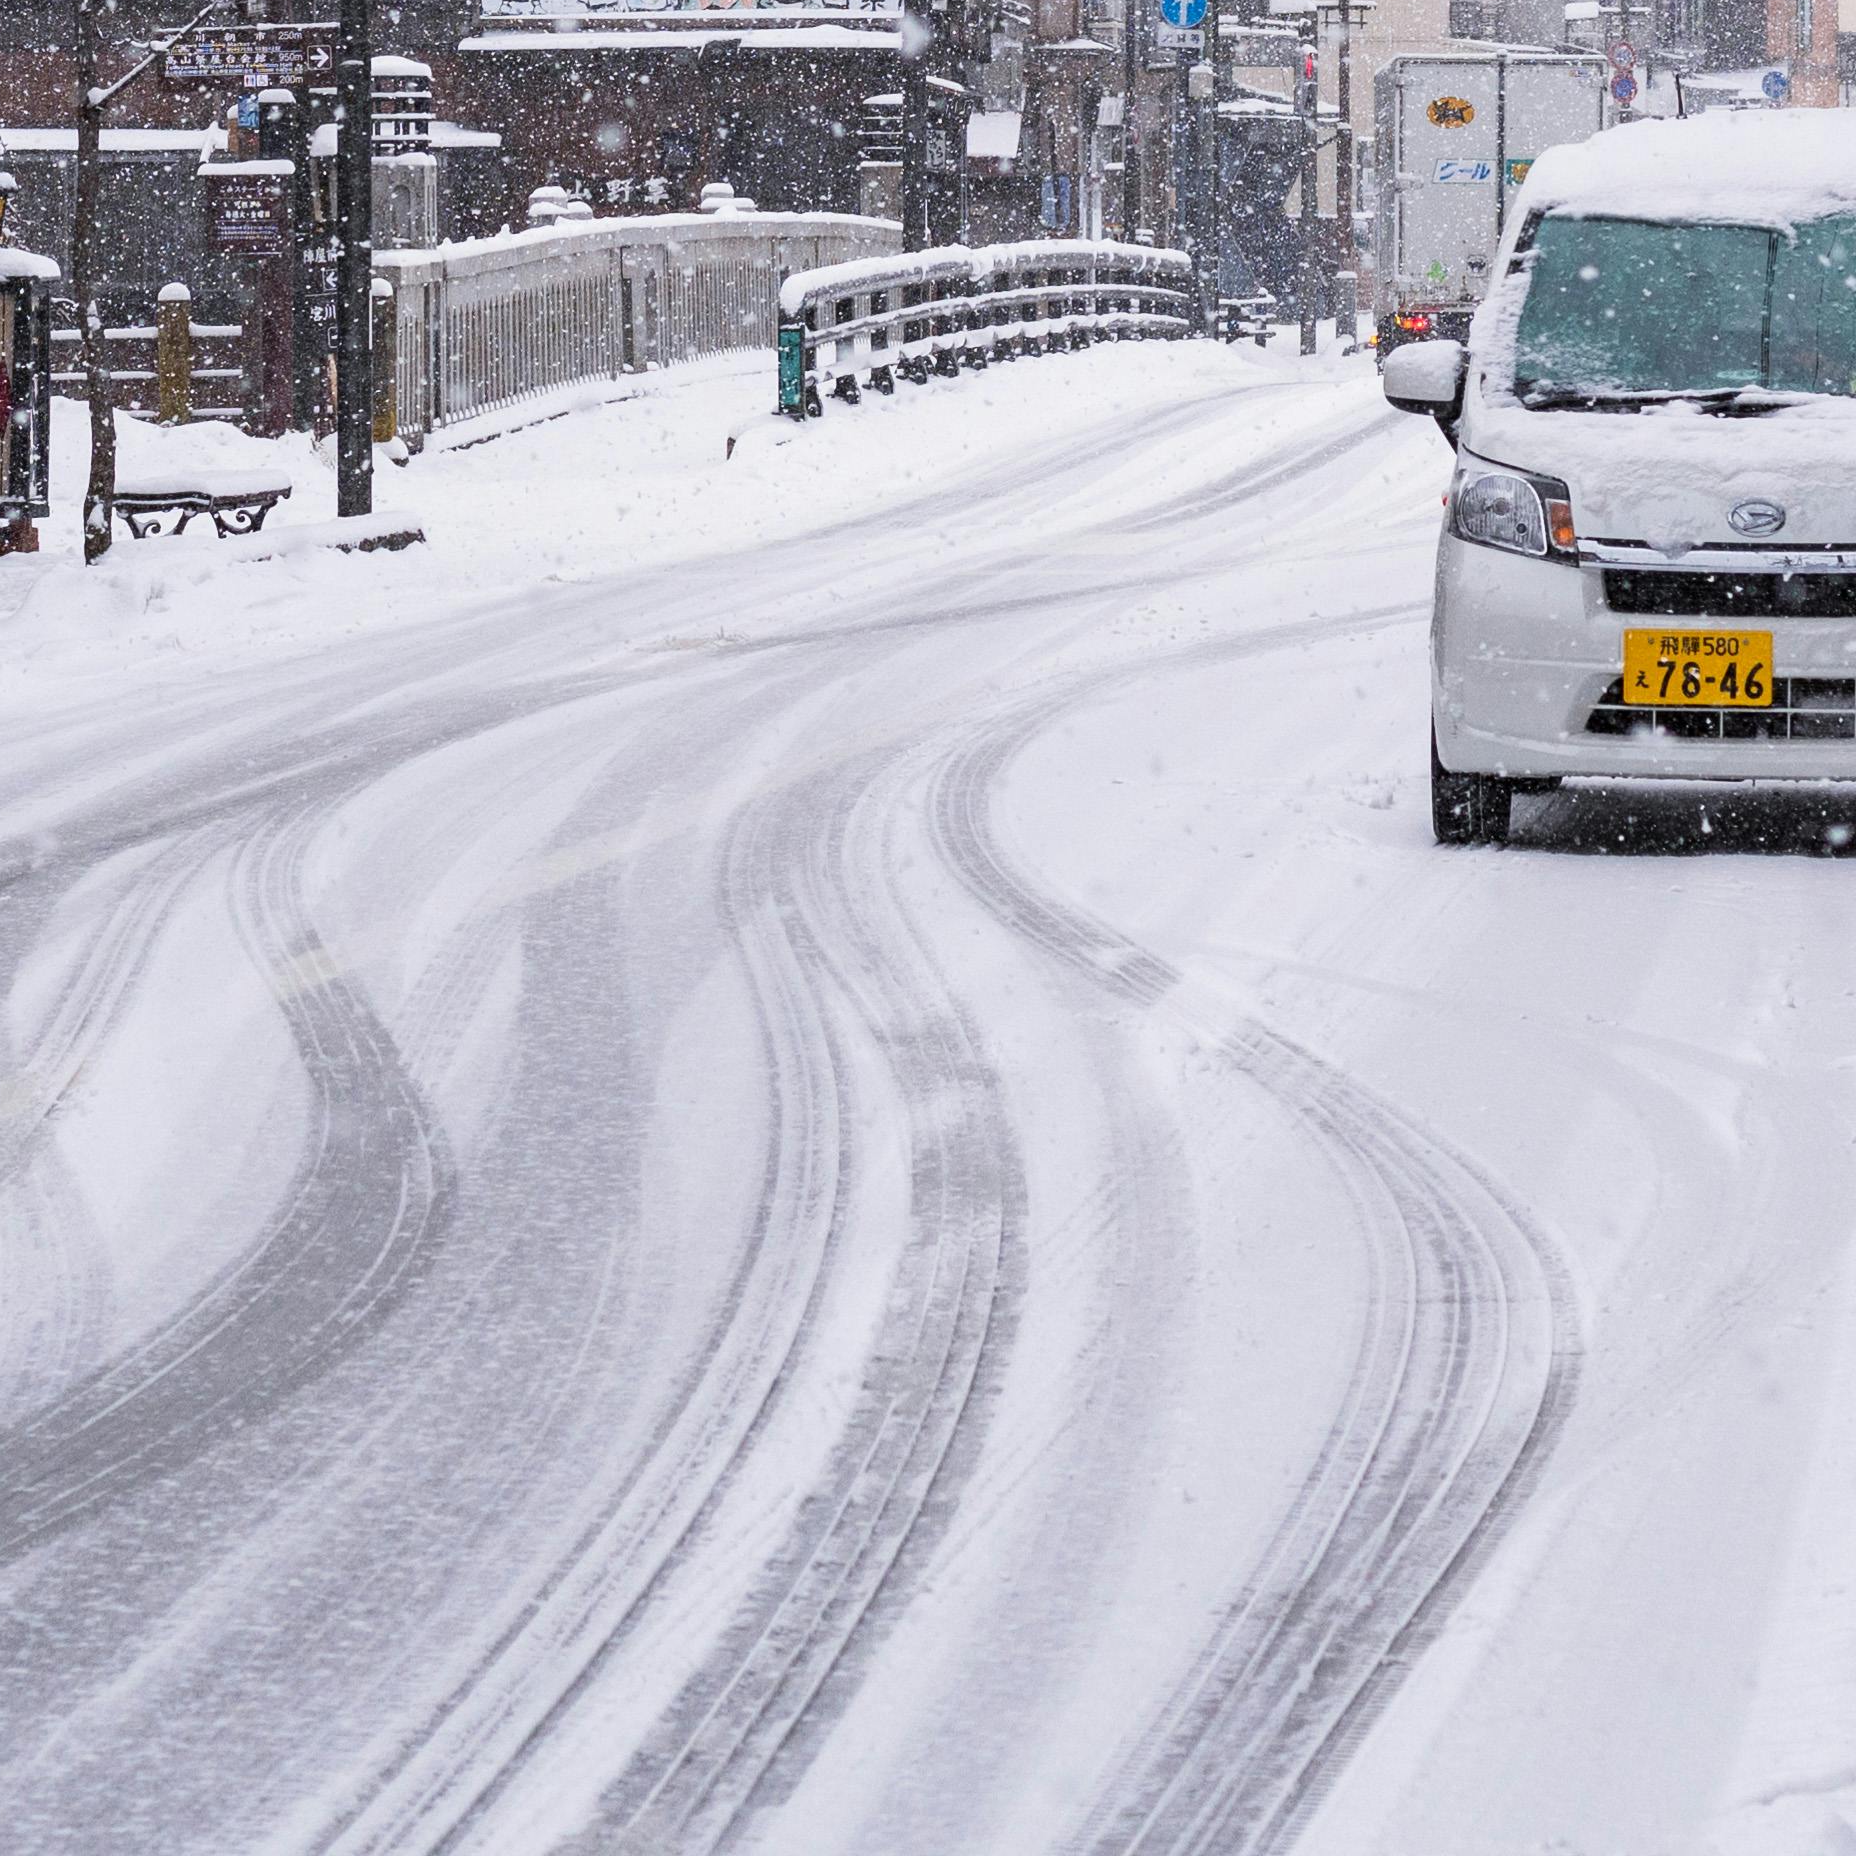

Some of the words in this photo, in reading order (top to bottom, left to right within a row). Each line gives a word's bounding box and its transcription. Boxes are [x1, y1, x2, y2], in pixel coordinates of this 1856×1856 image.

[278, 31, 303, 40] 250m
[279, 75, 304, 84] 200m
[1656, 660, 1765, 700] 78-46
